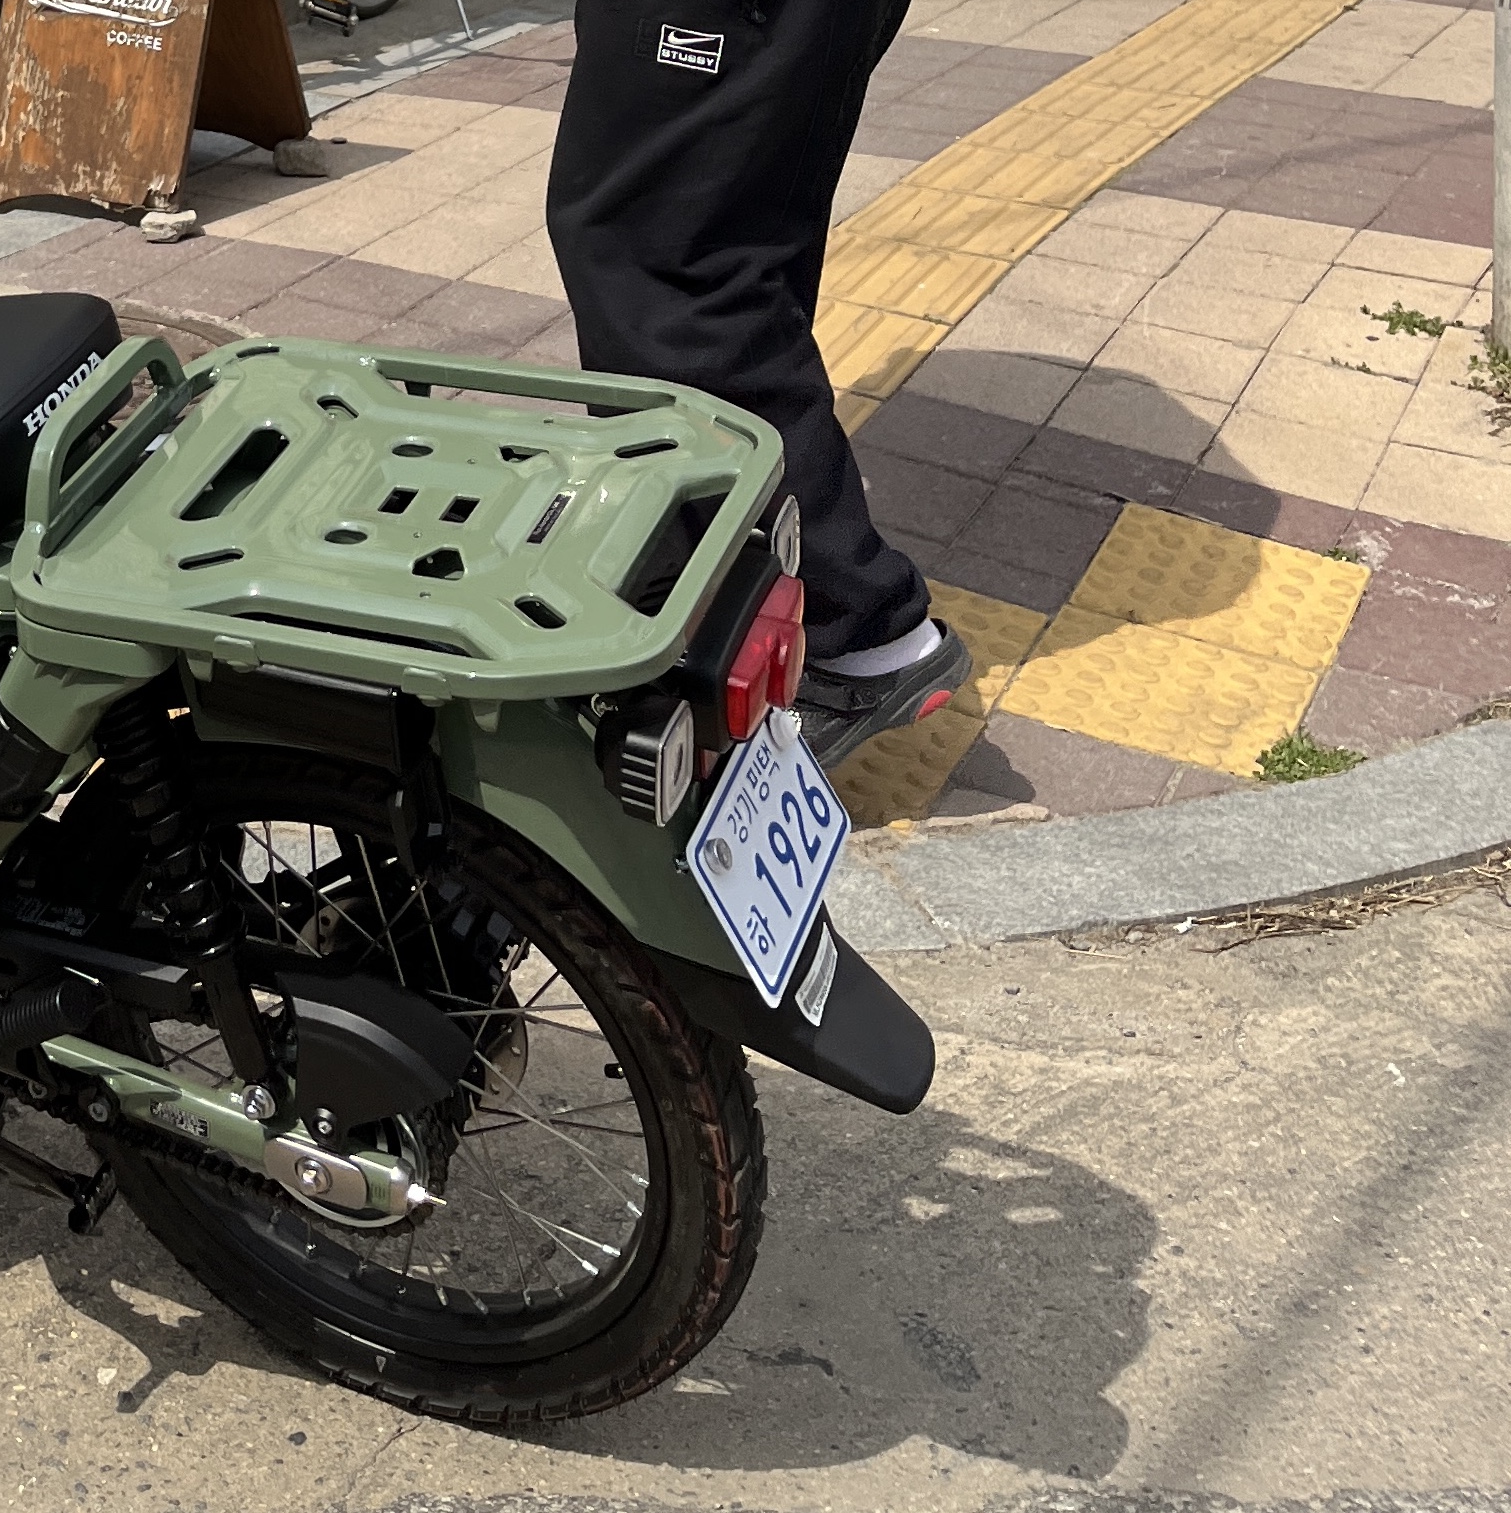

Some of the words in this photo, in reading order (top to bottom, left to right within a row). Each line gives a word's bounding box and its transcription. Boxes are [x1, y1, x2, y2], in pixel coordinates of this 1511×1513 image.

[106, 29, 163, 52] COFFEE
[661, 48, 715, 67] STUSSY
[22, 351, 104, 437] HONDA
[755, 762, 831, 918] 1926
[746, 904, 777, 955] 하
